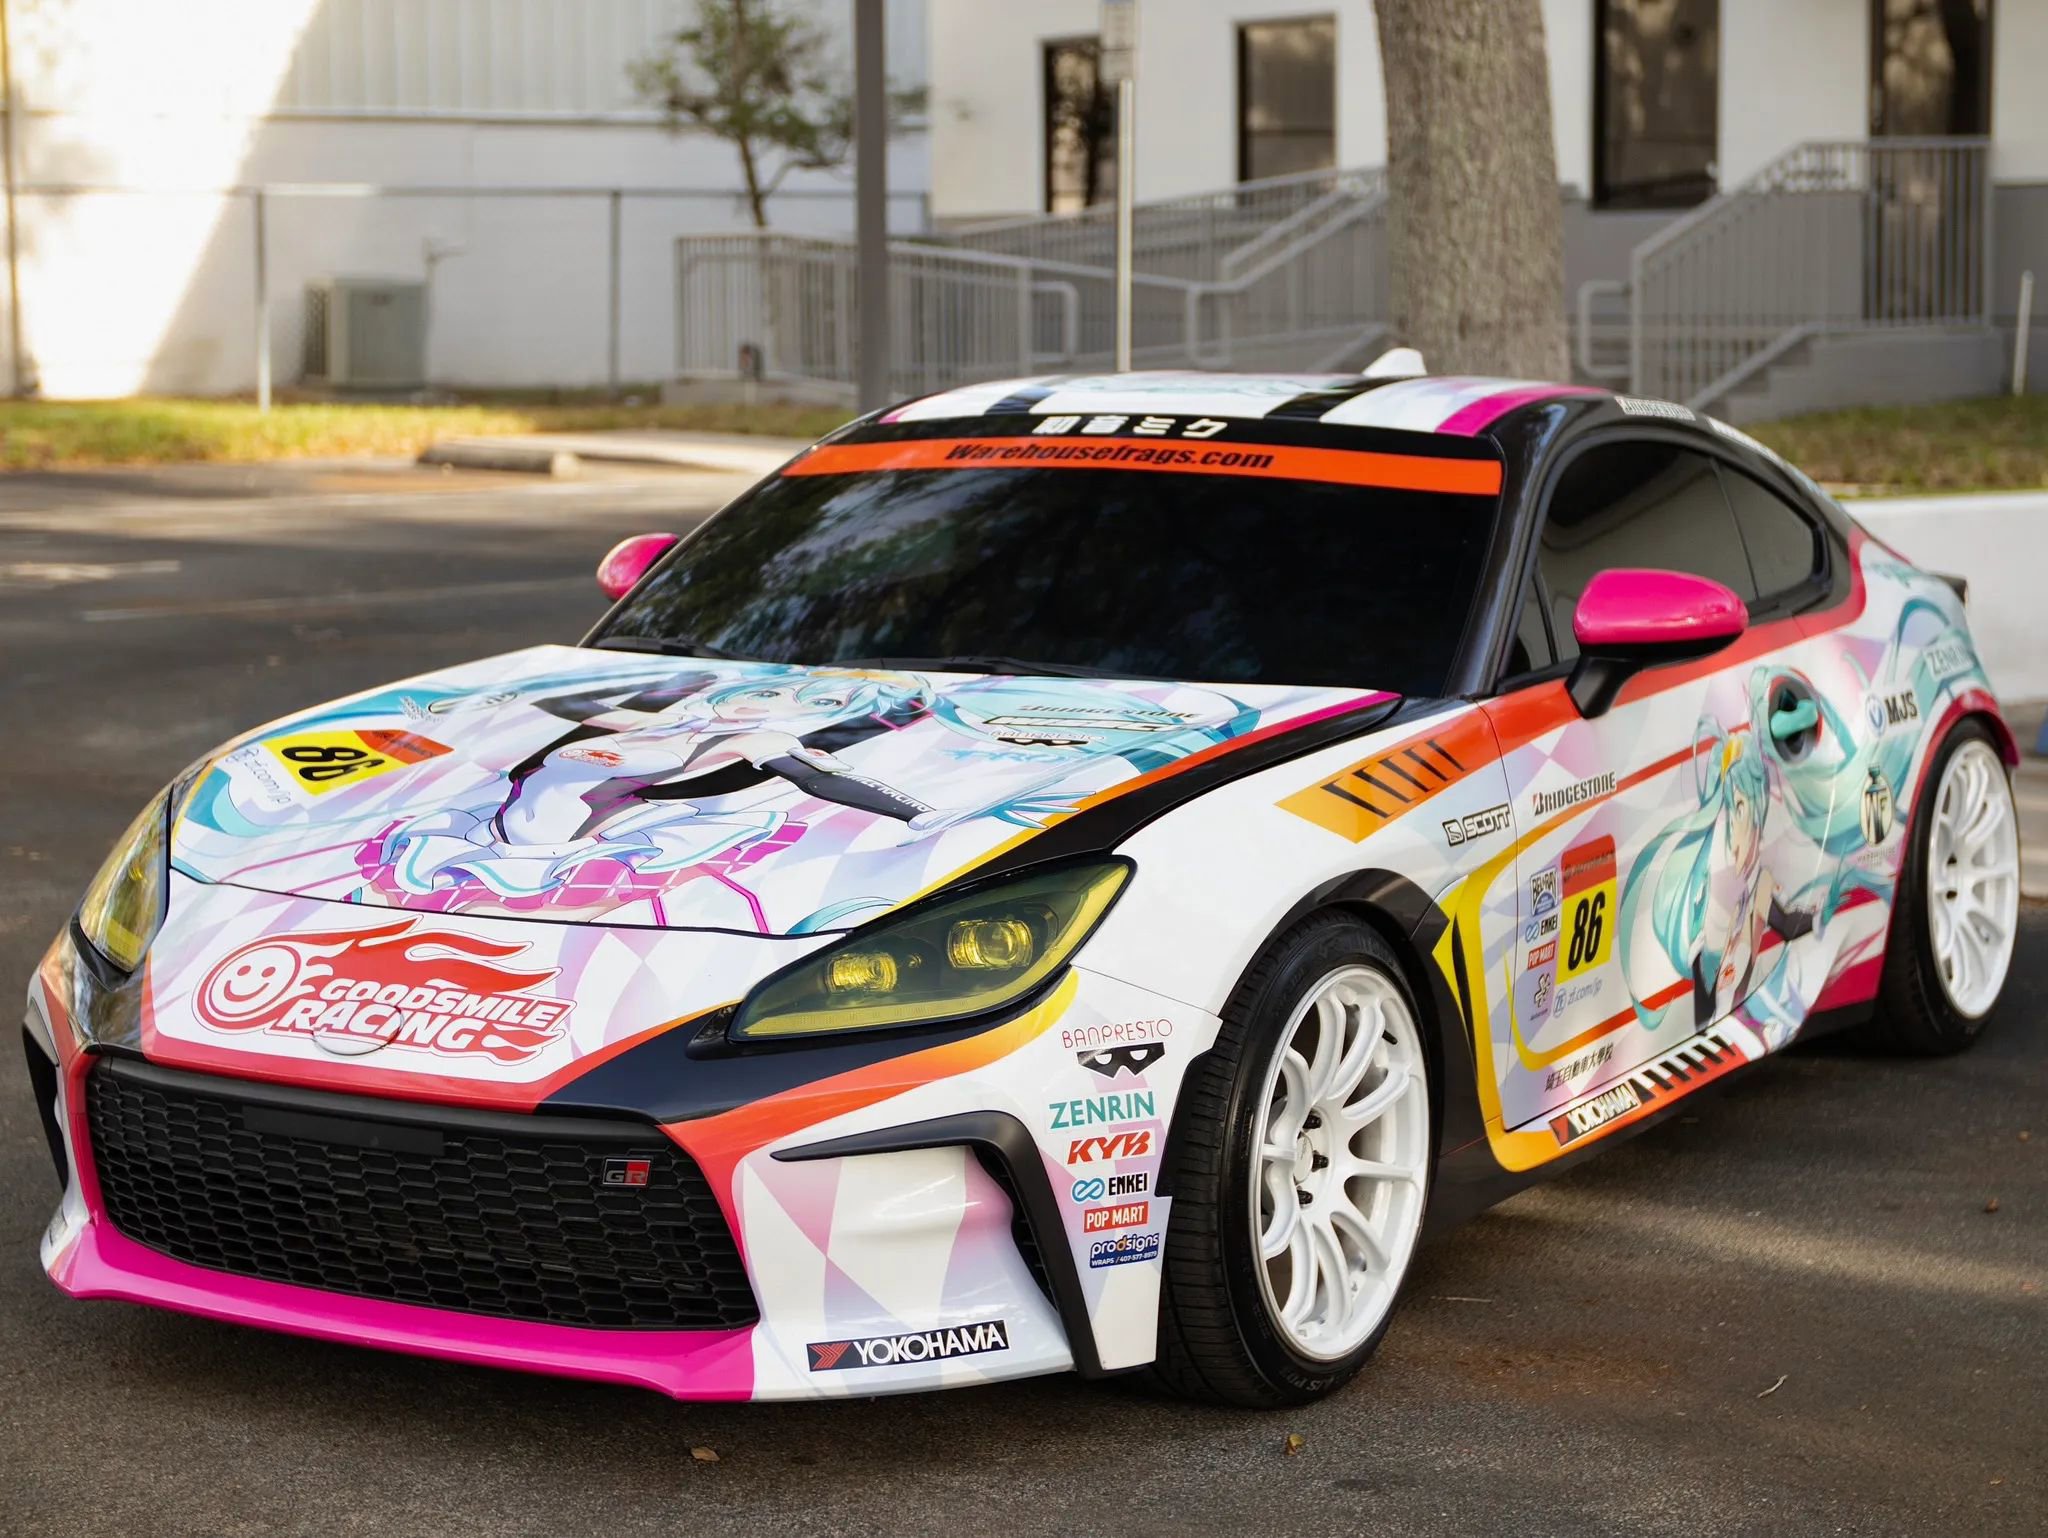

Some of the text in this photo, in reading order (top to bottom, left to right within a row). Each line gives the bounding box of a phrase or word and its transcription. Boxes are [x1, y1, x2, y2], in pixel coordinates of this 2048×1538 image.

[944, 444, 1275, 469] Warehousefrags.com
[1885, 688, 1918, 725] MJS
[281, 746, 385, 782] 86
[1533, 772, 1616, 816] BRIDGESTONE
[1464, 805, 1510, 840] SCOTT
[1568, 891, 1606, 971] 86
[320, 978, 564, 1029] GOODSMILE
[276, 1000, 487, 1049] RACING
[1062, 1019, 1173, 1049] BANPRESTO
[1049, 1091, 1155, 1130] ZENRIN
[1566, 1083, 1639, 1135] YOKOHAMA
[1067, 1131, 1151, 1165] KYB
[606, 1170, 646, 1183] GR
[1108, 1173, 1148, 1196] ENKEI
[1086, 1205, 1145, 1230] POP MART
[1091, 1233, 1160, 1259] prodsigns
[1091, 1257, 1115, 1266] WRAPS
[854, 1323, 1006, 1365] YOKOHAMA
